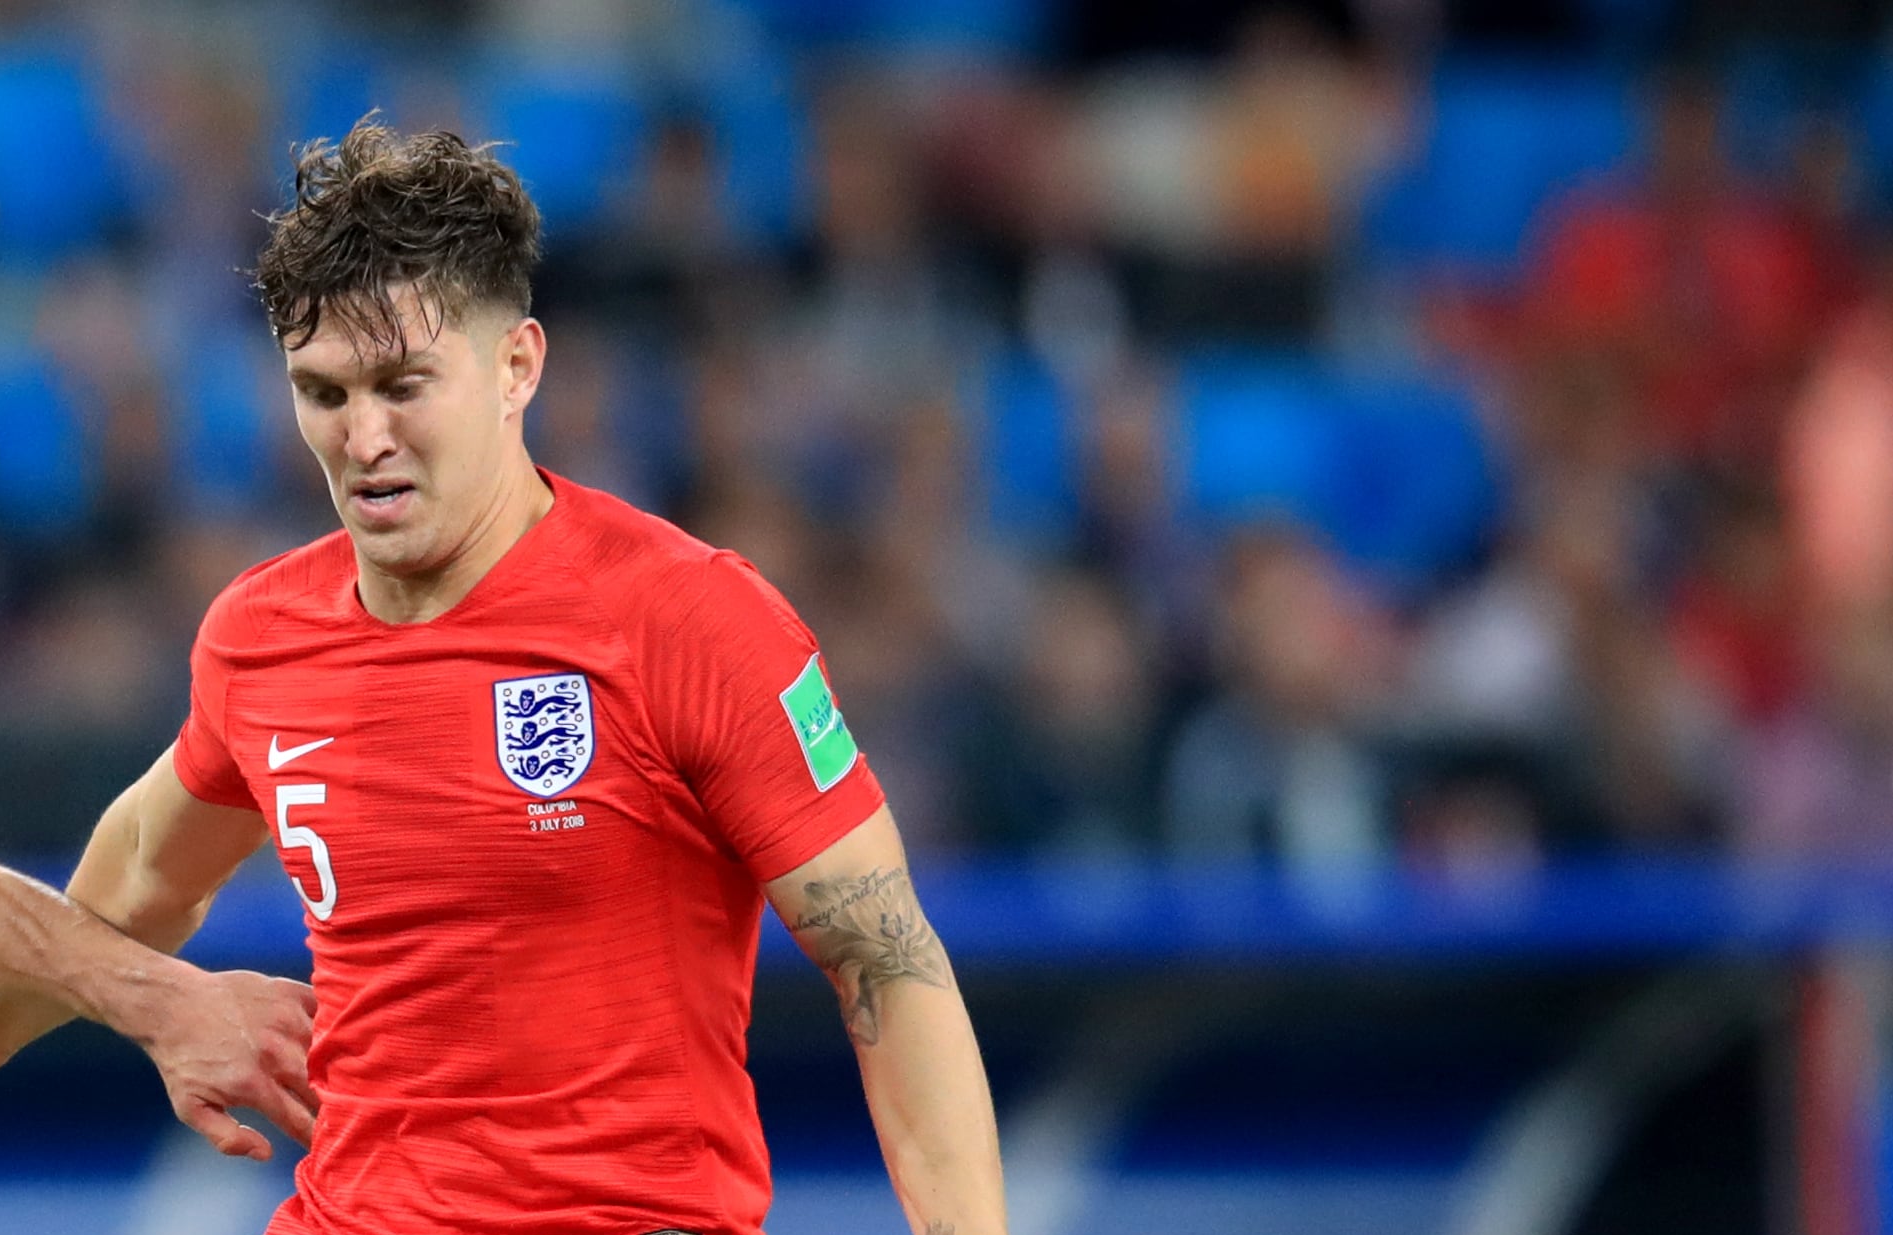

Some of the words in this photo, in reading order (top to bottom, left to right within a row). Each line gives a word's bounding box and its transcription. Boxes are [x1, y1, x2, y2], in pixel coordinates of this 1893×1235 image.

[527, 800, 577, 816] COLOMBIA
[529, 820, 538, 832] 3
[540, 817, 560, 831] JULY
[562, 814, 585, 829] 2018
[275, 783, 338, 921] 5
